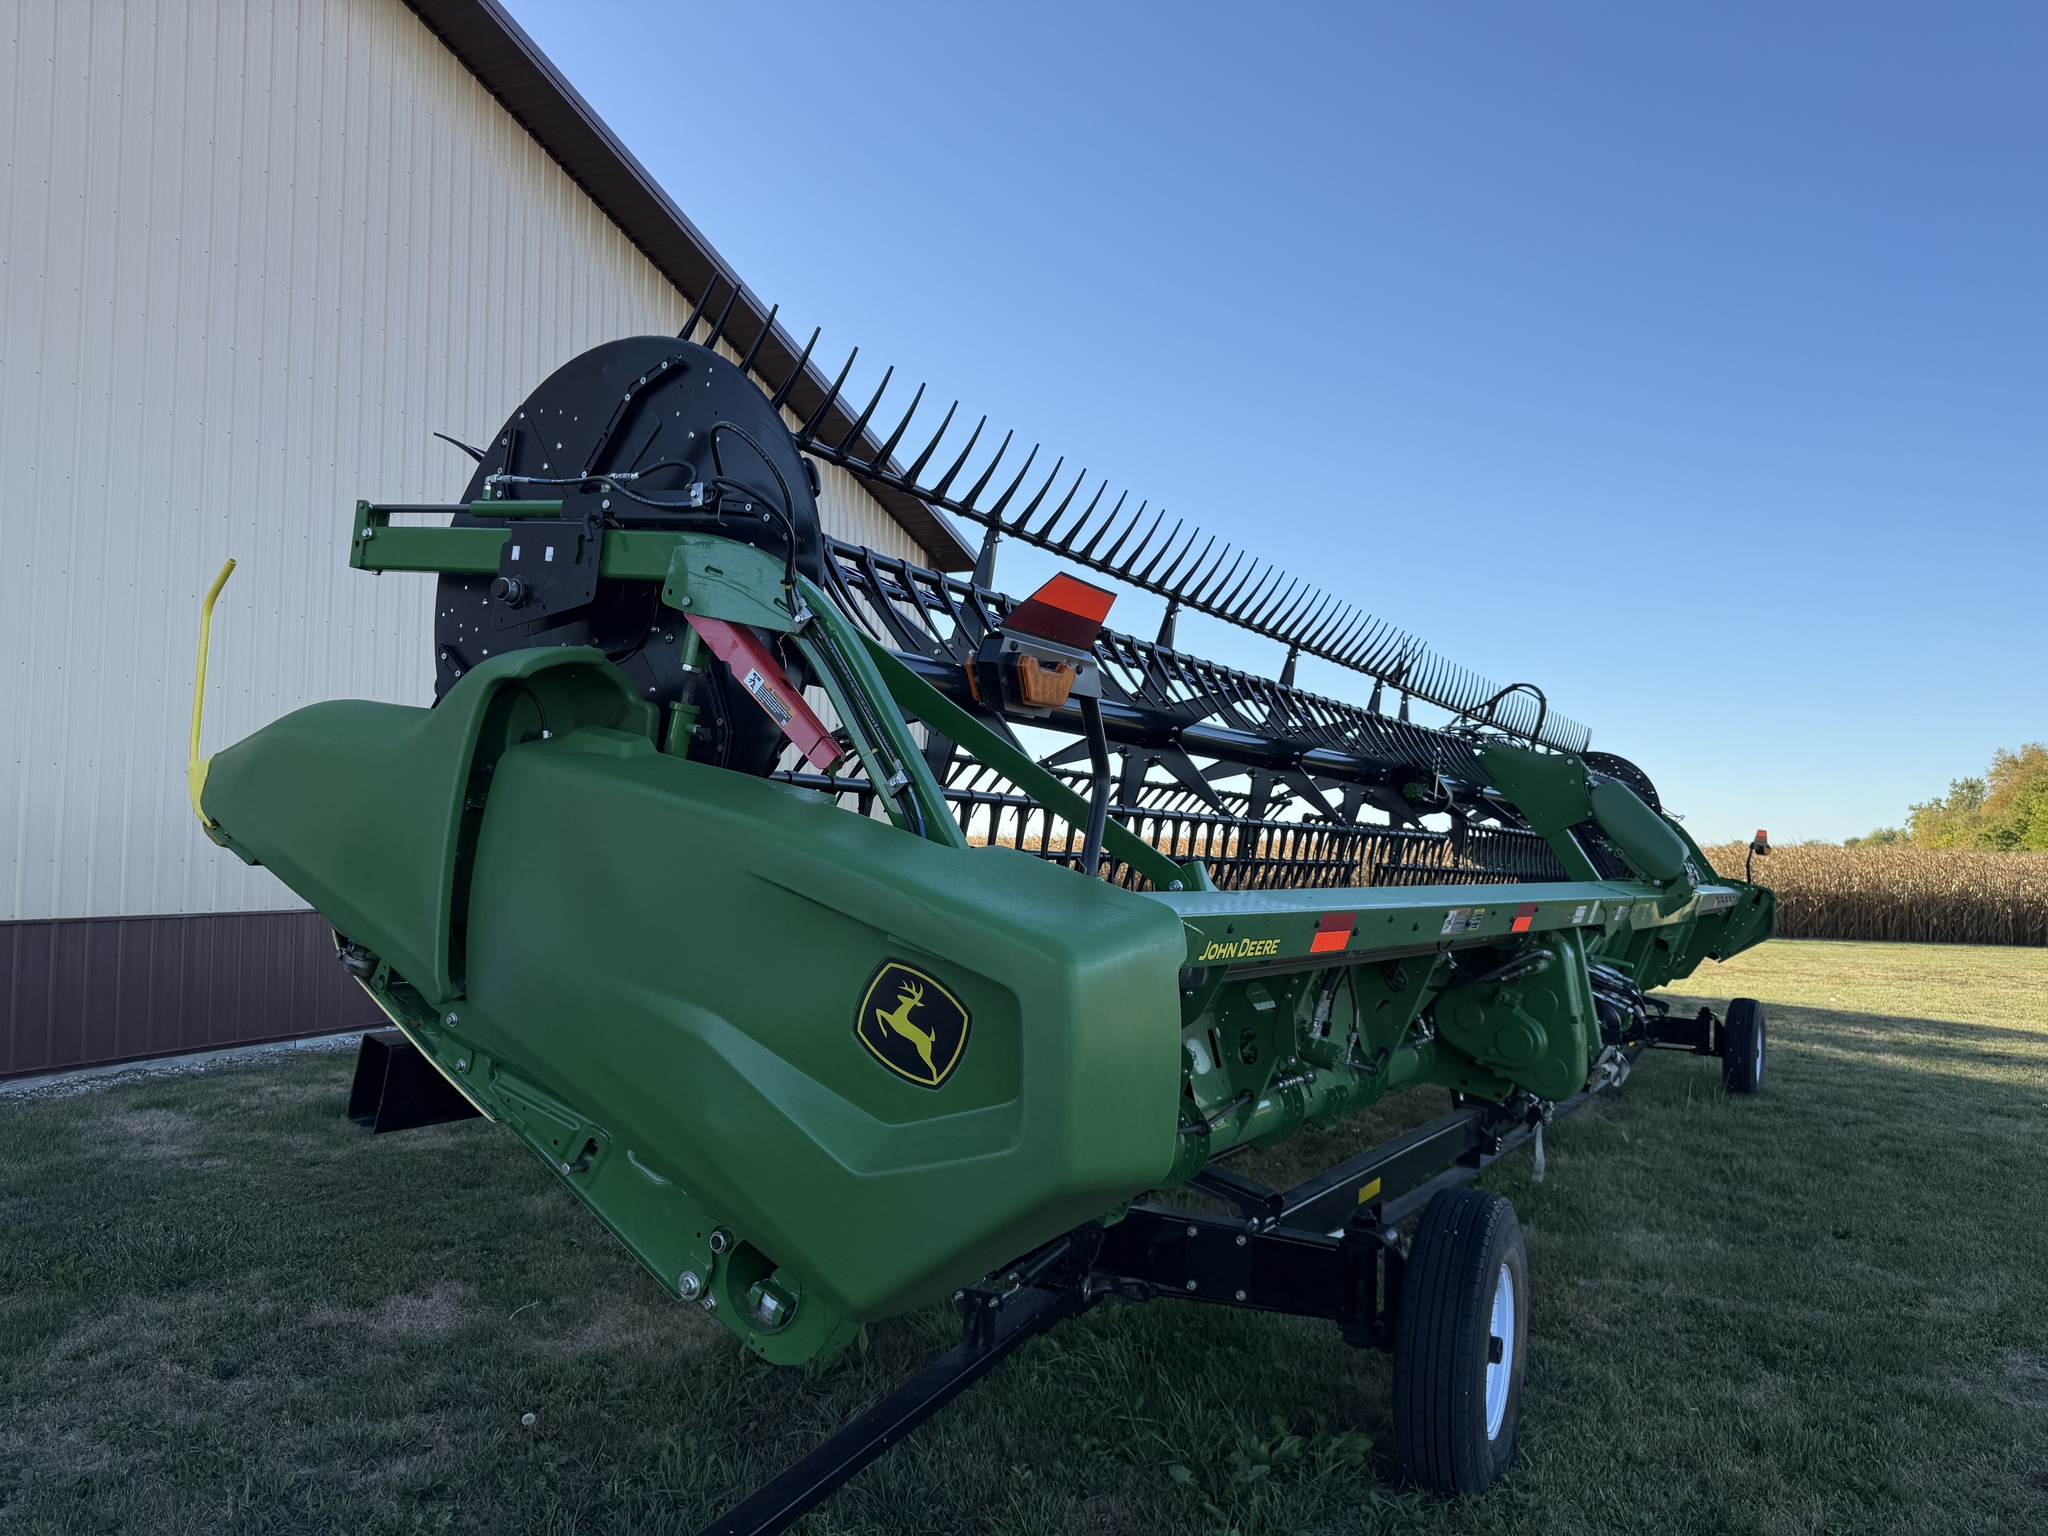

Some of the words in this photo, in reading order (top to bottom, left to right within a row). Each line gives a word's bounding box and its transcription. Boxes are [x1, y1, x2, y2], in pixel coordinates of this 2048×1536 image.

[773, 690, 791, 711] WARNING
[1198, 940, 1239, 961] JOHN
[1237, 938, 1281, 958] DEERE
